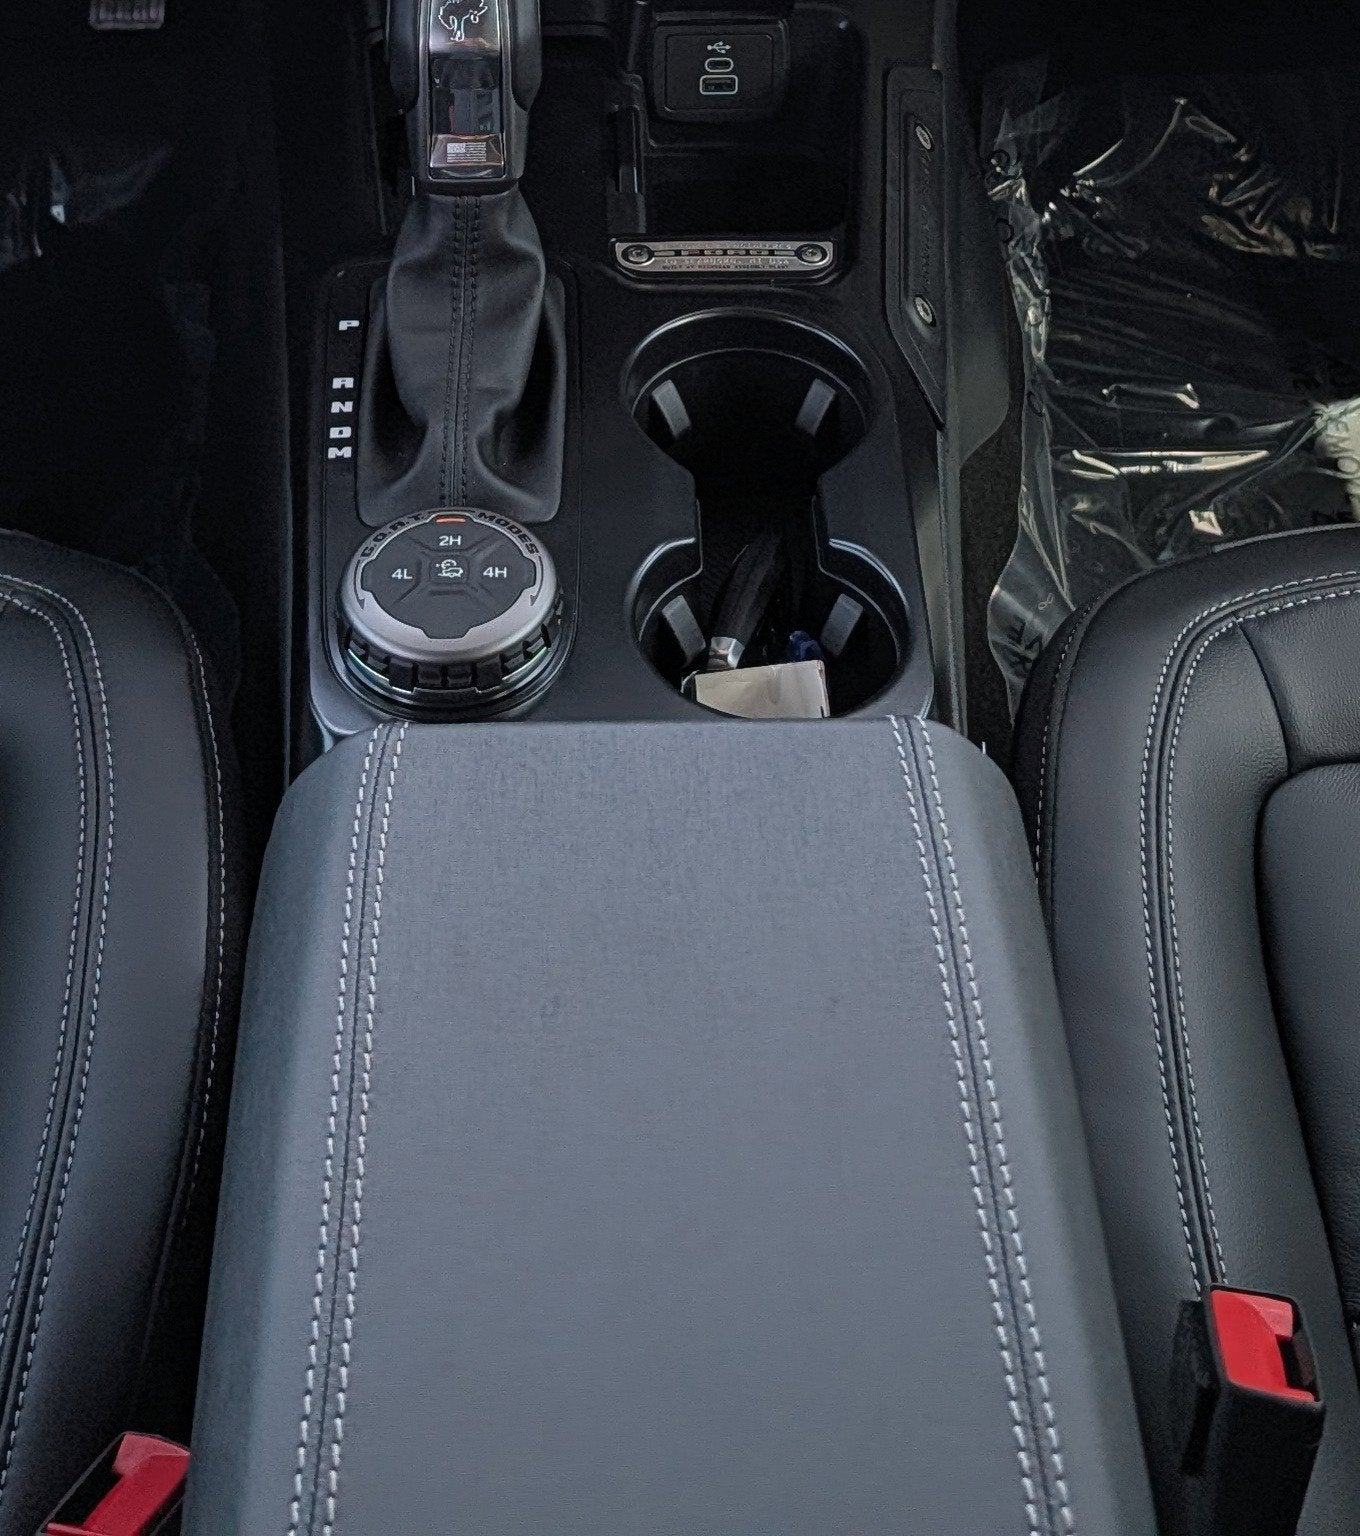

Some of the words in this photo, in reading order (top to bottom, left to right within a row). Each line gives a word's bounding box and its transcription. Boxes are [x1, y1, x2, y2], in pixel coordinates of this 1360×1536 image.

[339, 320, 360, 331] P
[330, 401, 353, 413] N
[330, 427, 352, 438] D
[327, 446, 352, 459] M
[478, 512, 540, 555] MODES
[438, 536, 462, 547] 2H
[391, 571, 413, 580] 4L
[482, 567, 508, 579] 4H
